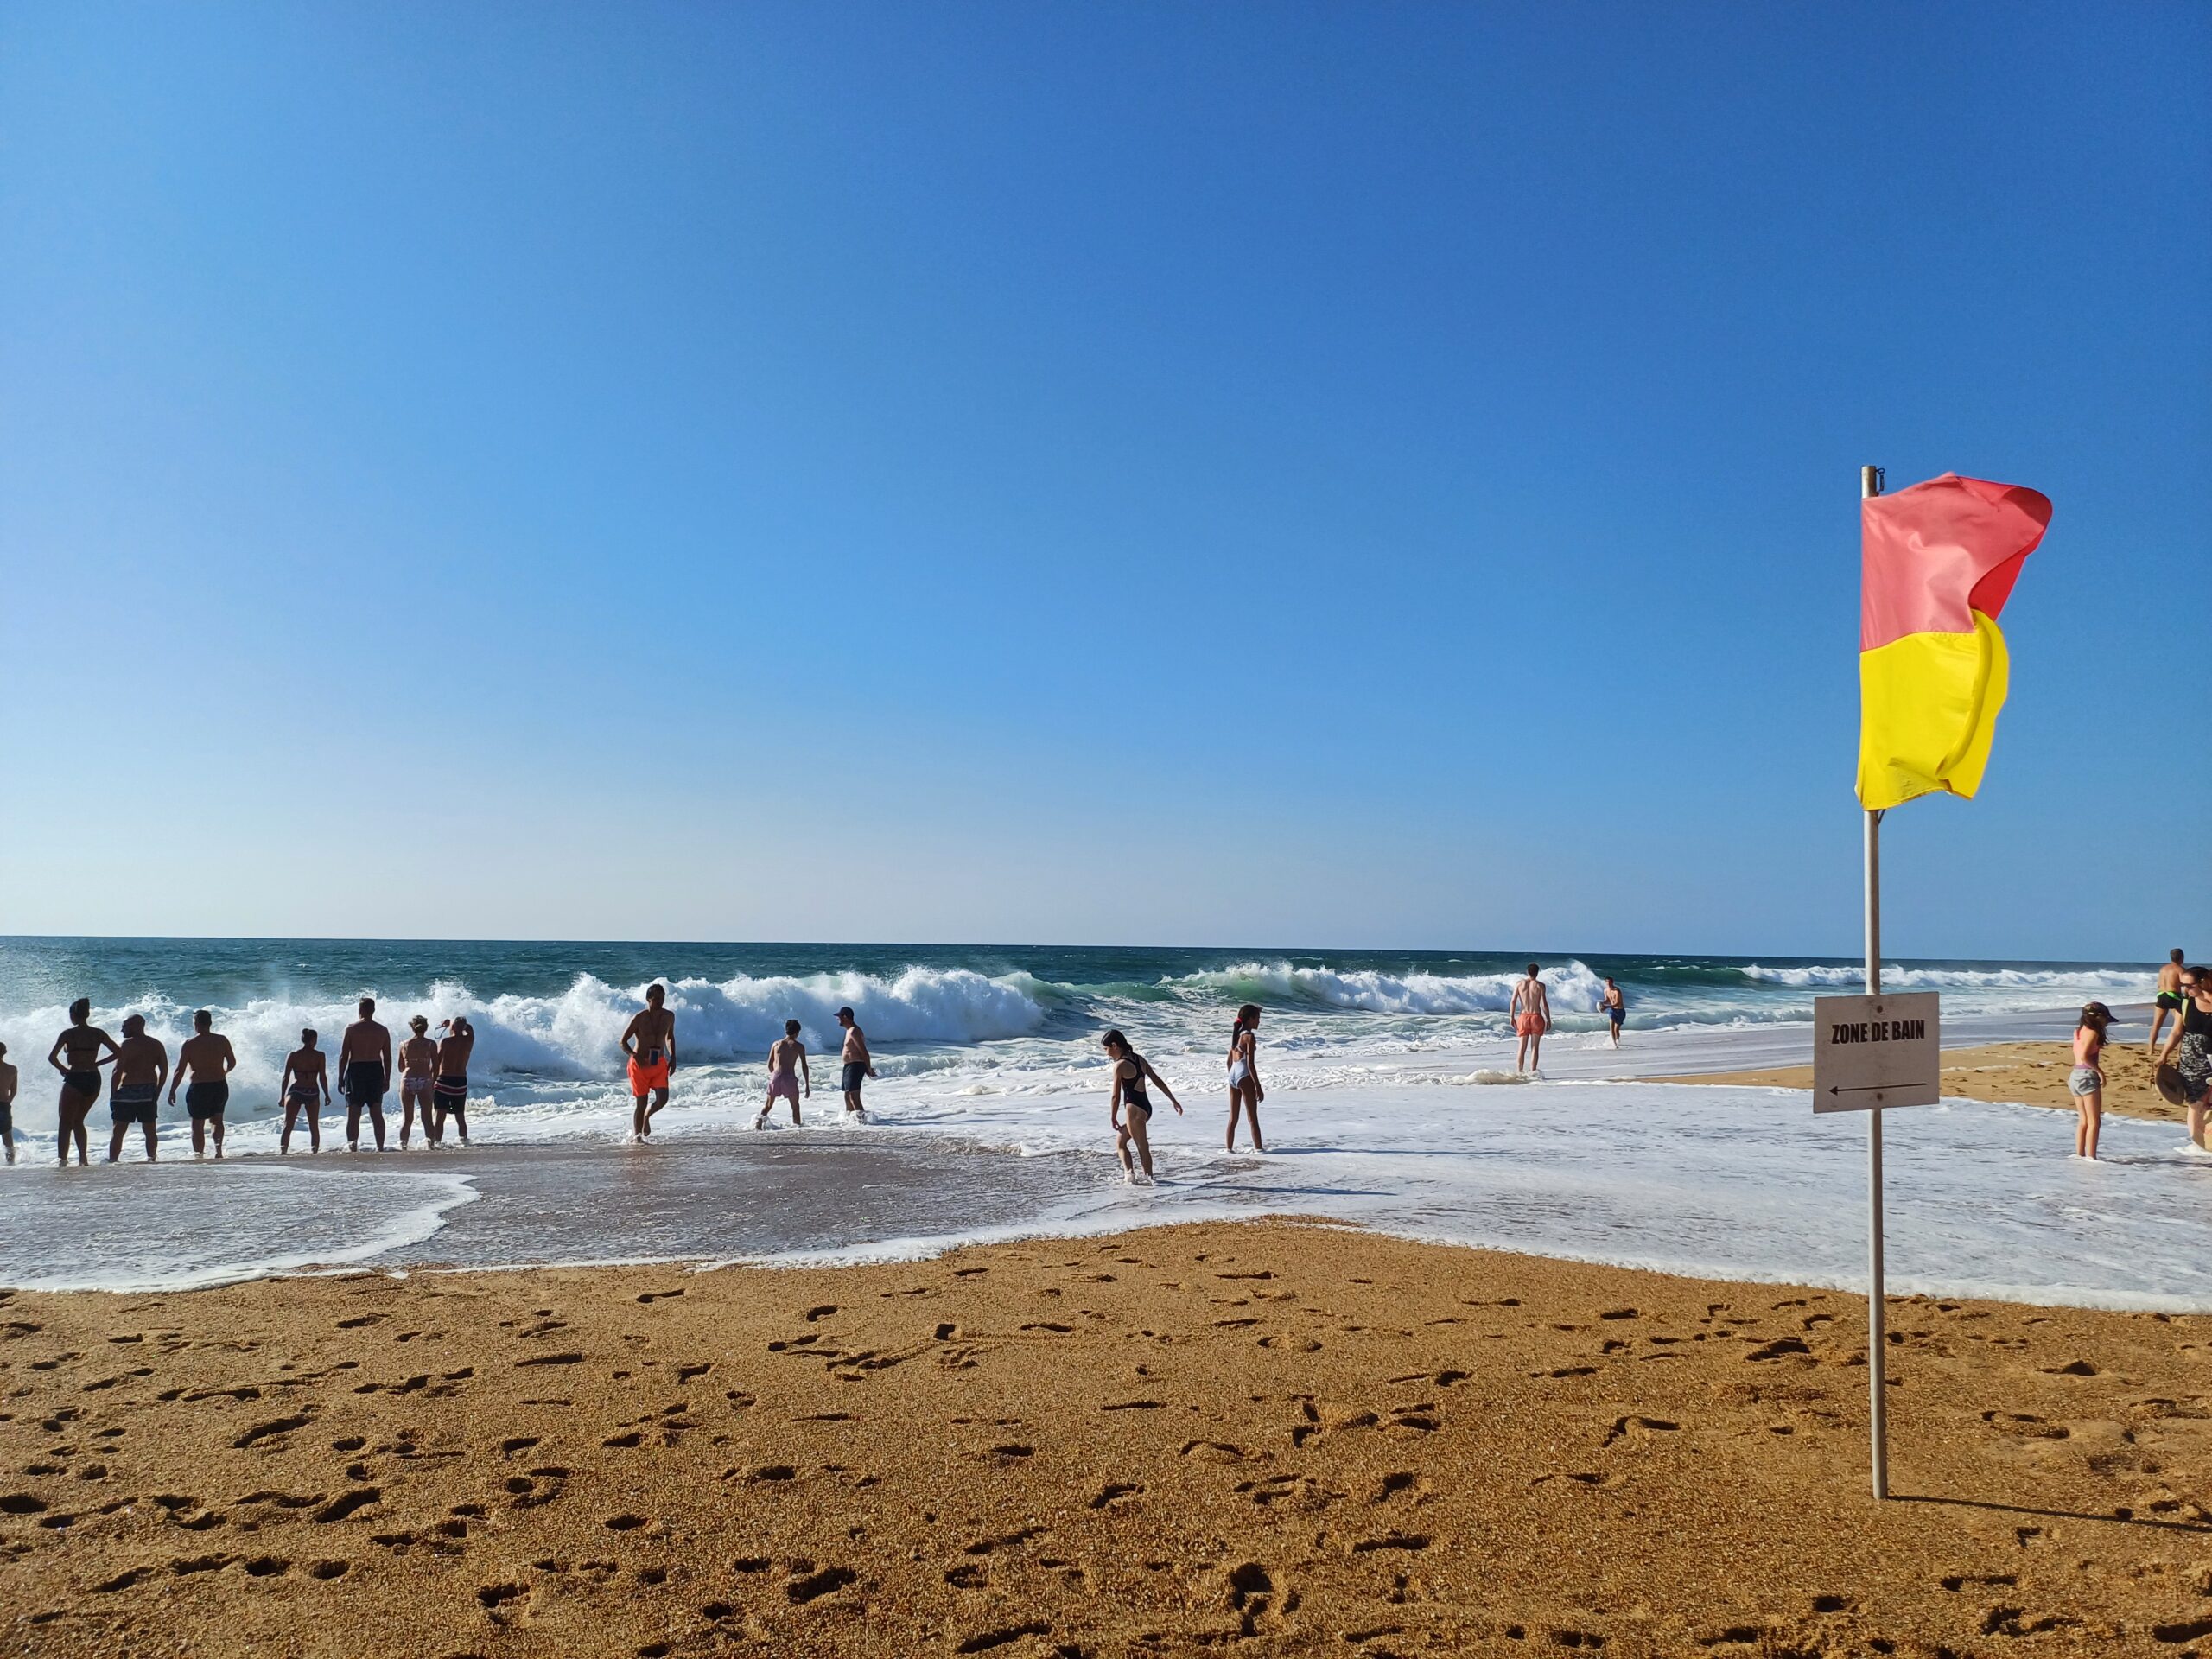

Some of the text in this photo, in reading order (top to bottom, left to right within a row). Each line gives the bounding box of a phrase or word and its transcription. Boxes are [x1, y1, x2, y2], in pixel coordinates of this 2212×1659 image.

[1832, 1020, 1925, 1044] ZONE DE BAIN
